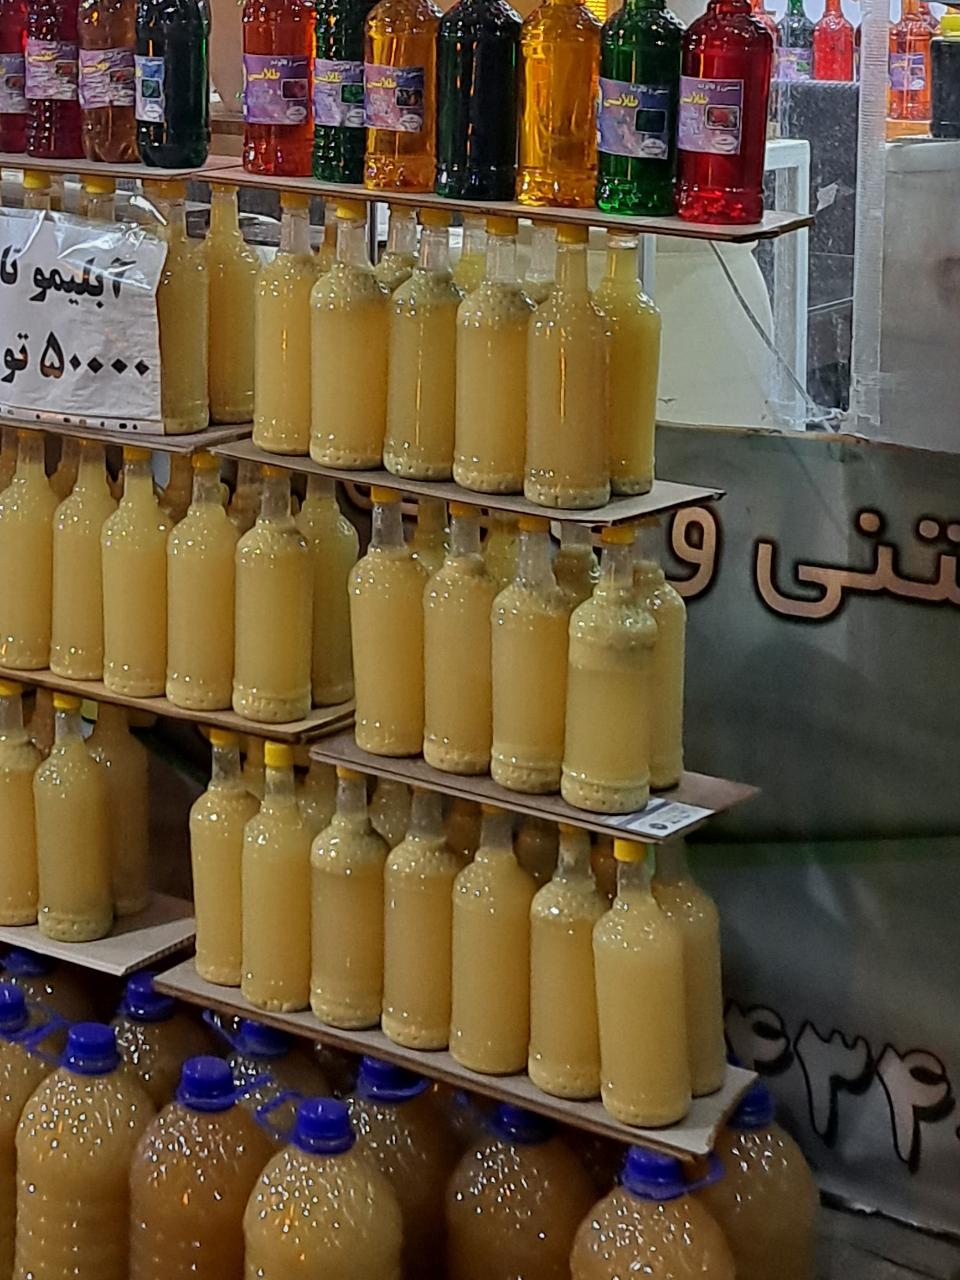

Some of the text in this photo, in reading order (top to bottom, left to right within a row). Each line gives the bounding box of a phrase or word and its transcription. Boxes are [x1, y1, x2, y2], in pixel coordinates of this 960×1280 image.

[29, 257, 137, 309] آبلیمو
[40, 331, 150, 379] ۵۰۰۰۰
[756, 511, 960, 619] تنی
